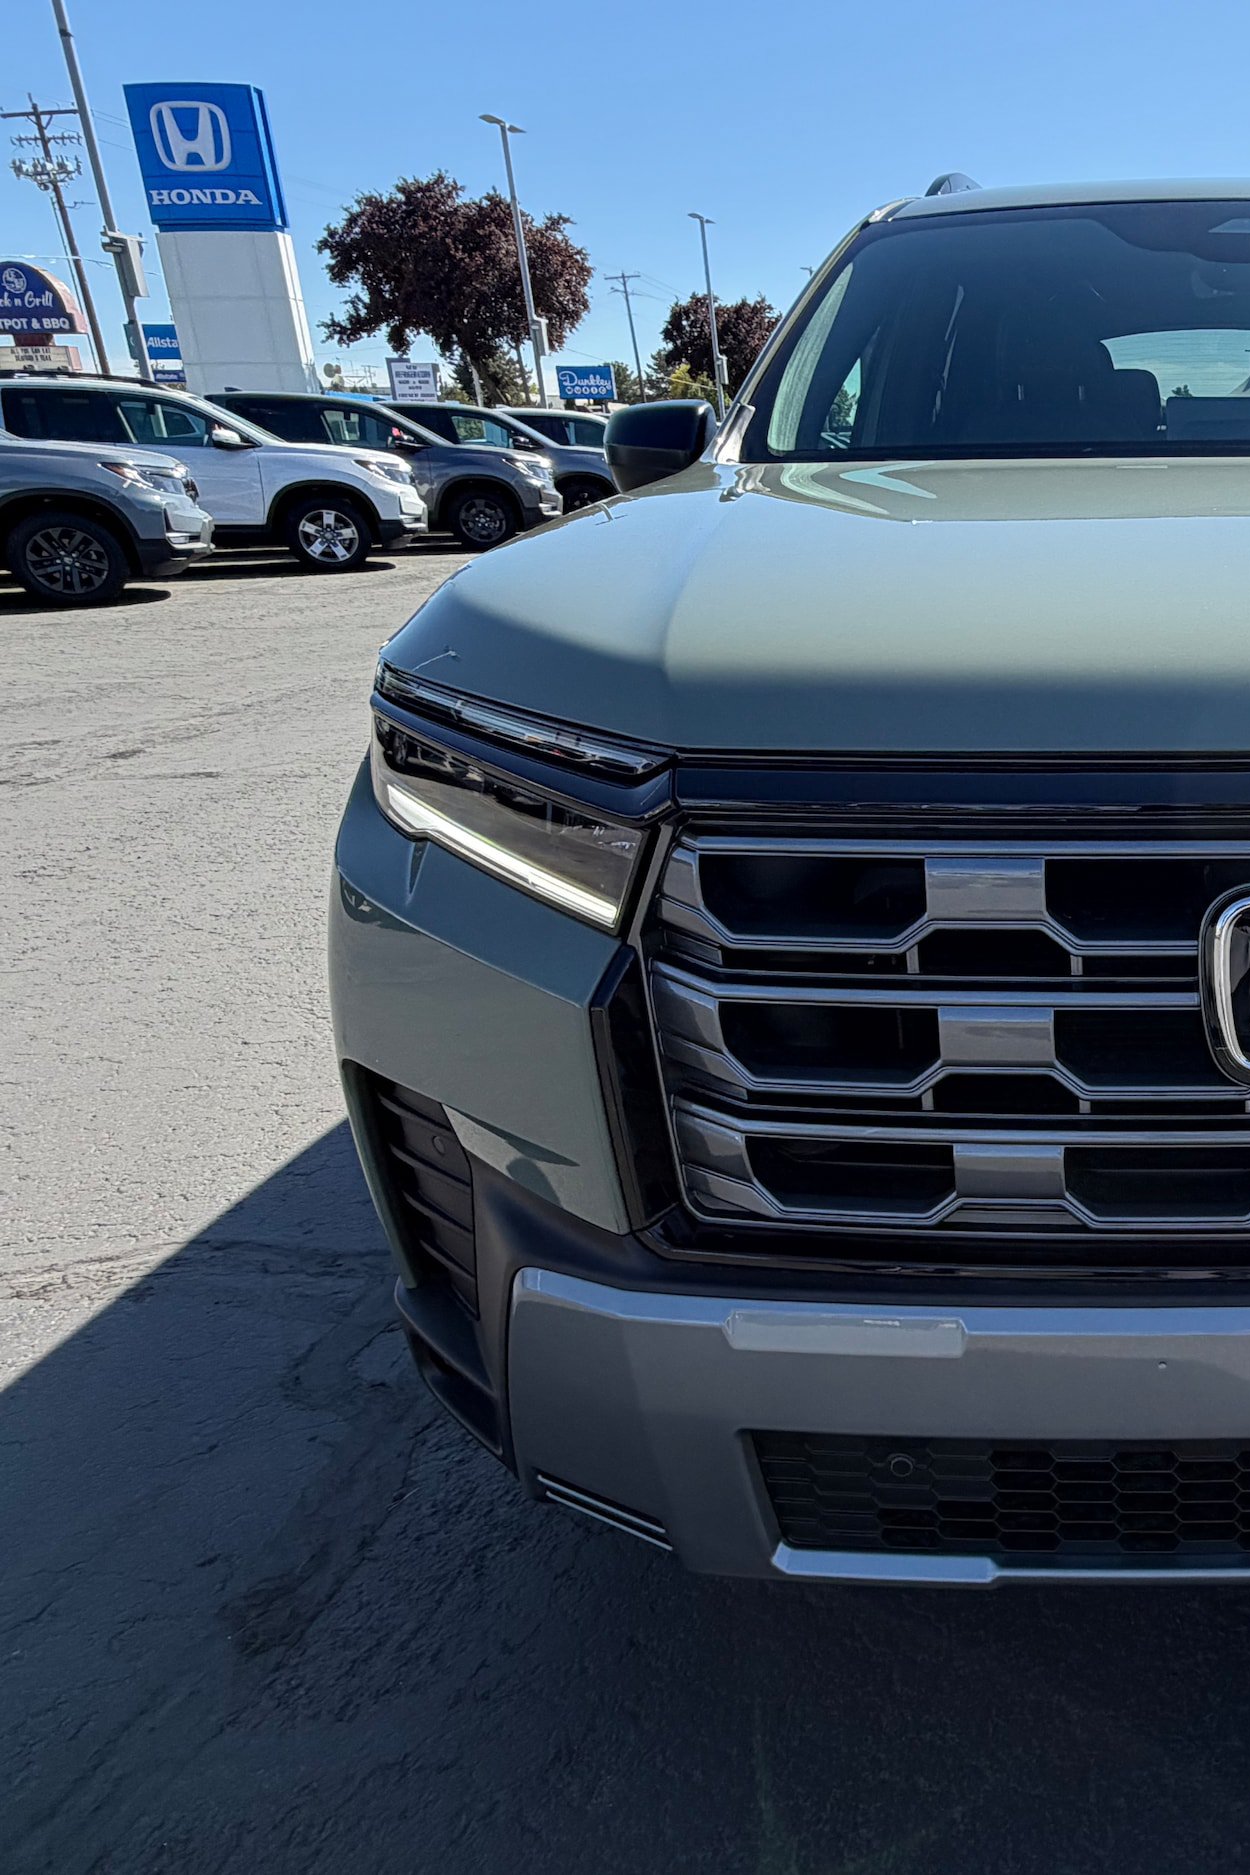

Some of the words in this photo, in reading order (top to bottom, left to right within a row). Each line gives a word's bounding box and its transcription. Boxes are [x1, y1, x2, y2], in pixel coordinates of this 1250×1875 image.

[149, 188, 263, 205] HONDA
[24, 290, 54, 308] Grill
[31, 317, 41, 330] &
[42, 317, 70, 330] BBQ
[558, 370, 612, 390] Dunkley
